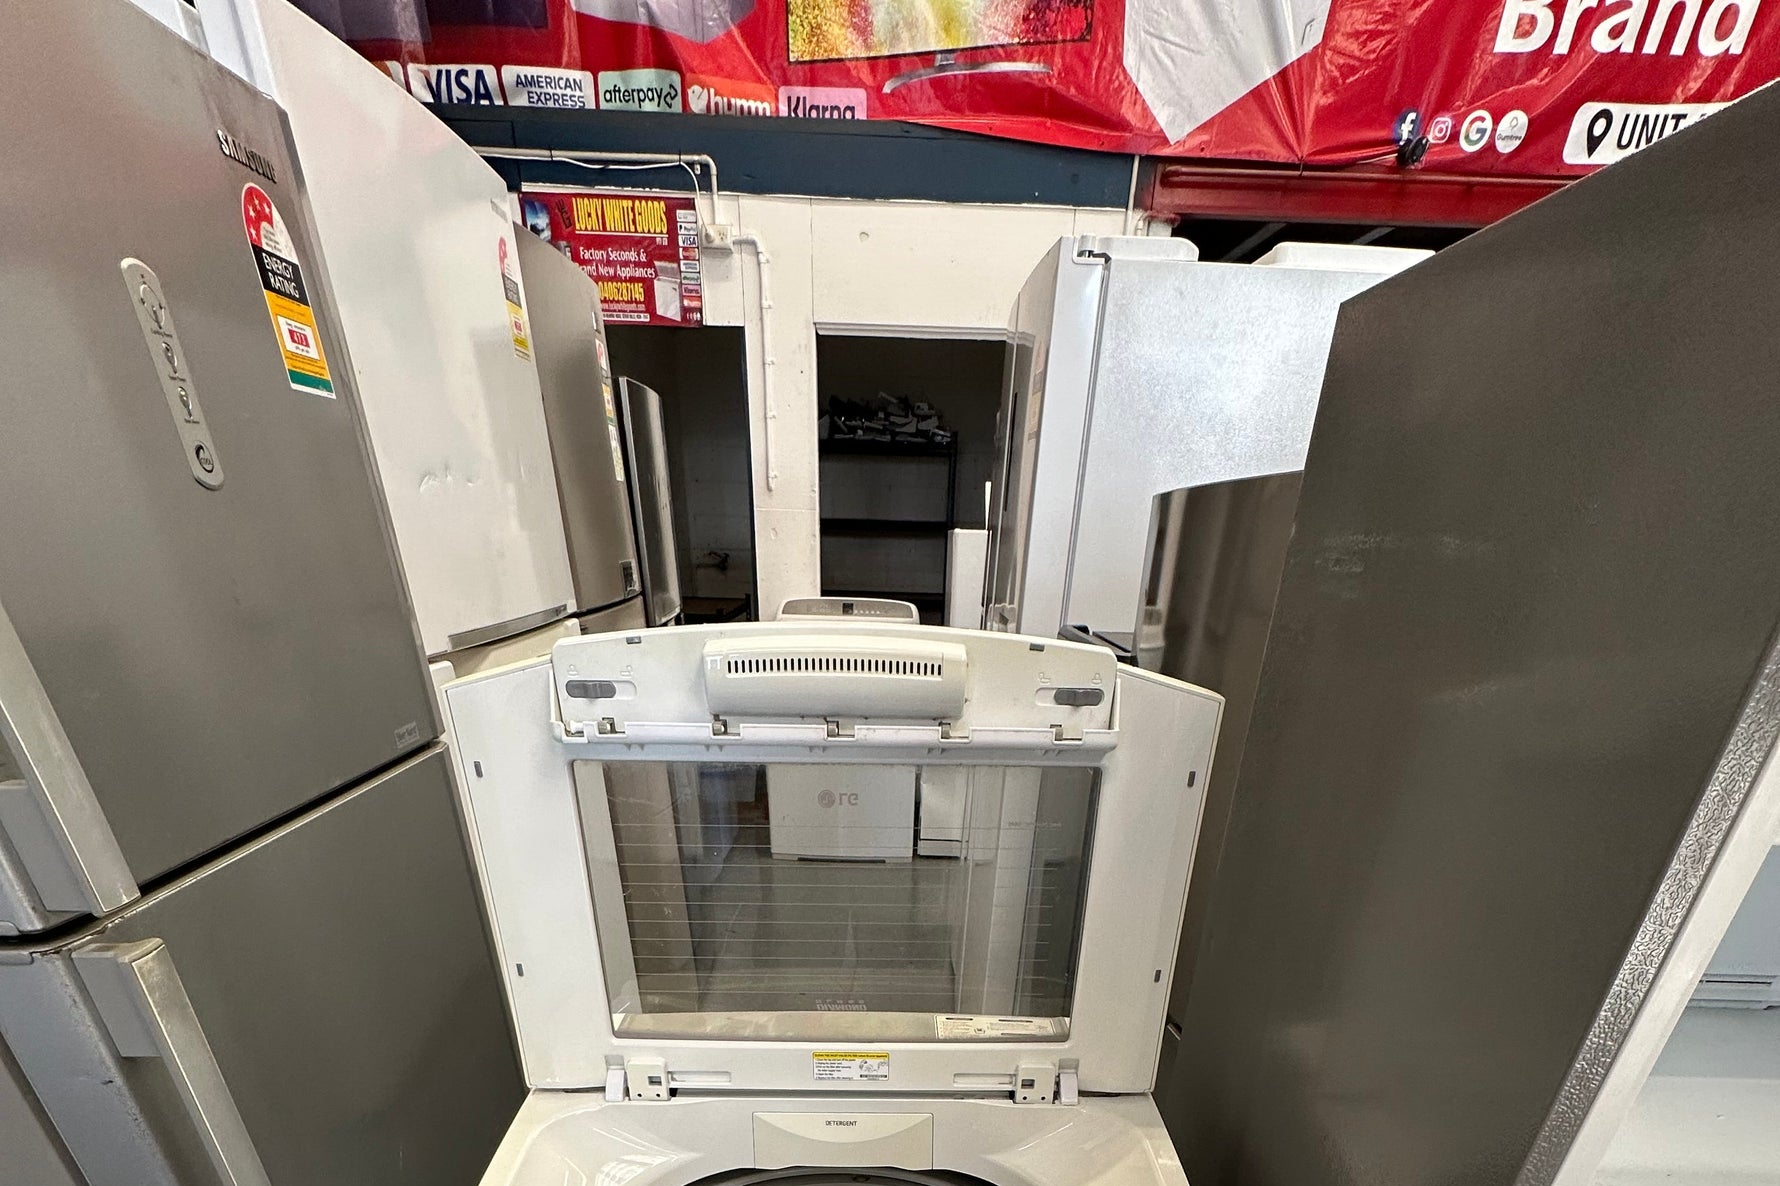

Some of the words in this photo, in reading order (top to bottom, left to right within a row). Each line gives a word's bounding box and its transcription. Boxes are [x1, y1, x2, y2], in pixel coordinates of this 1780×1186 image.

[1493, 0, 1760, 56] Brand
[419, 68, 496, 105] VISA
[515, 73, 583, 93] AMERICAN
[603, 84, 663, 107] afterpay
[527, 90, 586, 109] EXPRESS
[709, 88, 771, 117] humm
[1616, 113, 1688, 151] UNIT
[572, 197, 603, 231] LUCKY
[602, 198, 635, 232] WHITE
[634, 199, 667, 234] GOODS
[579, 246, 606, 263] Factory
[608, 247, 638, 263] Seconds
[640, 248, 647, 262] &
[681, 236, 697, 246] VISA
[262, 252, 294, 280] ENERGY
[598, 263, 615, 277] New
[617, 264, 655, 280] Appliances
[268, 271, 300, 299] RATING
